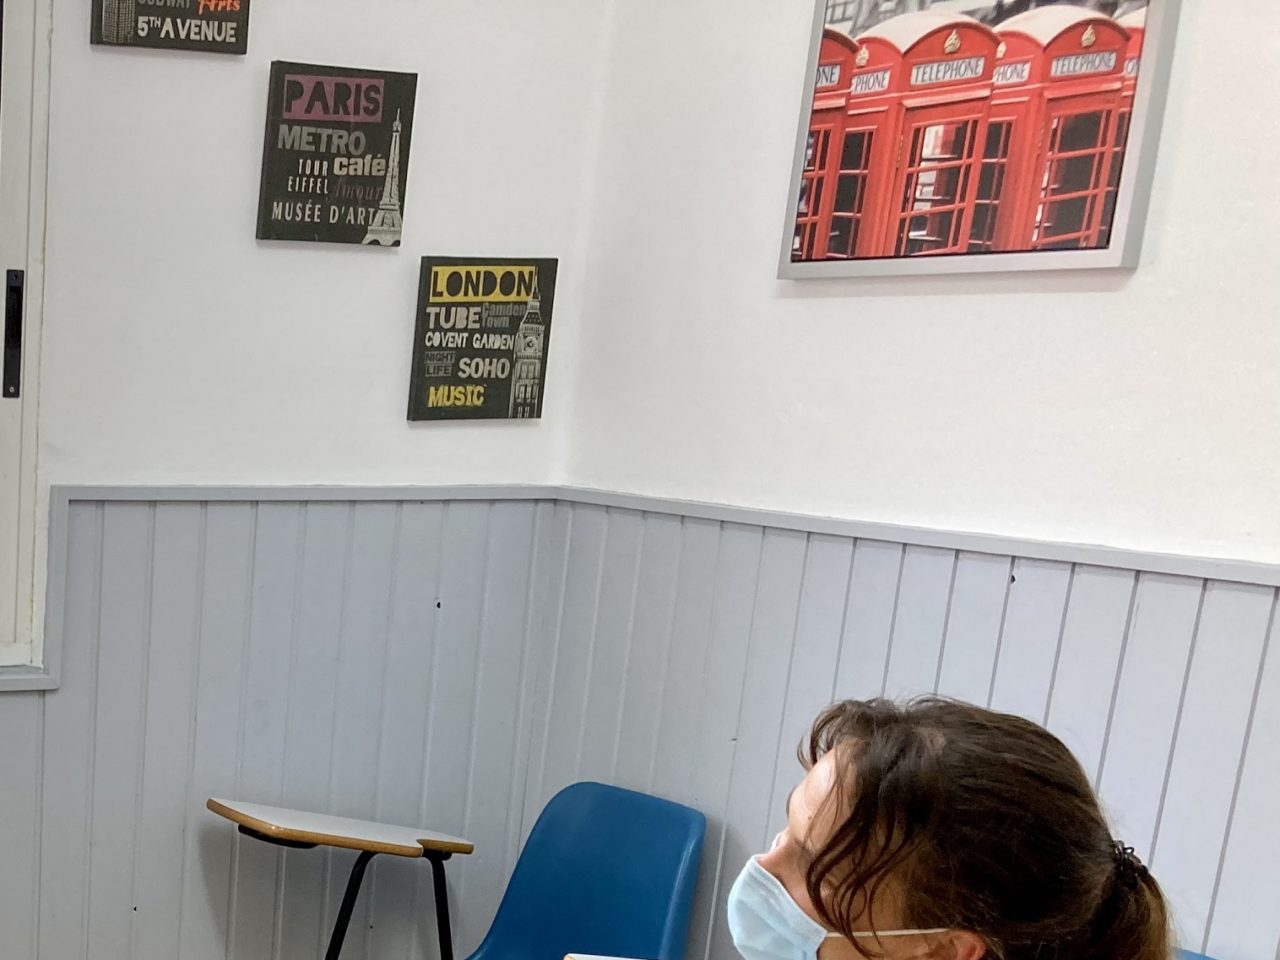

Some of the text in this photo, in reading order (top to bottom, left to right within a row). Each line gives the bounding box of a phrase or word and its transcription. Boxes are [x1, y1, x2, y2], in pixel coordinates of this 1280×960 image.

[160, 18, 237, 43] AVENUE
[914, 57, 981, 82] TELEPHONE
[993, 62, 1027, 82] HONE
[1053, 53, 1114, 75] TELEPHONE
[284, 79, 381, 117] PARIS
[278, 124, 367, 156] METRO
[299, 159, 329, 177] TOUR
[333, 154, 386, 176] café
[288, 176, 329, 194] EIFFEL
[272, 199, 376, 226] MUSÉE D'ART
[432, 270, 534, 298] LONDON
[426, 306, 481, 330] TUBE
[425, 331, 515, 350] COVENT GARDEN
[426, 364, 451, 376] LIFE
[458, 357, 510, 379] SOHO
[428, 384, 485, 407] MUSIC
